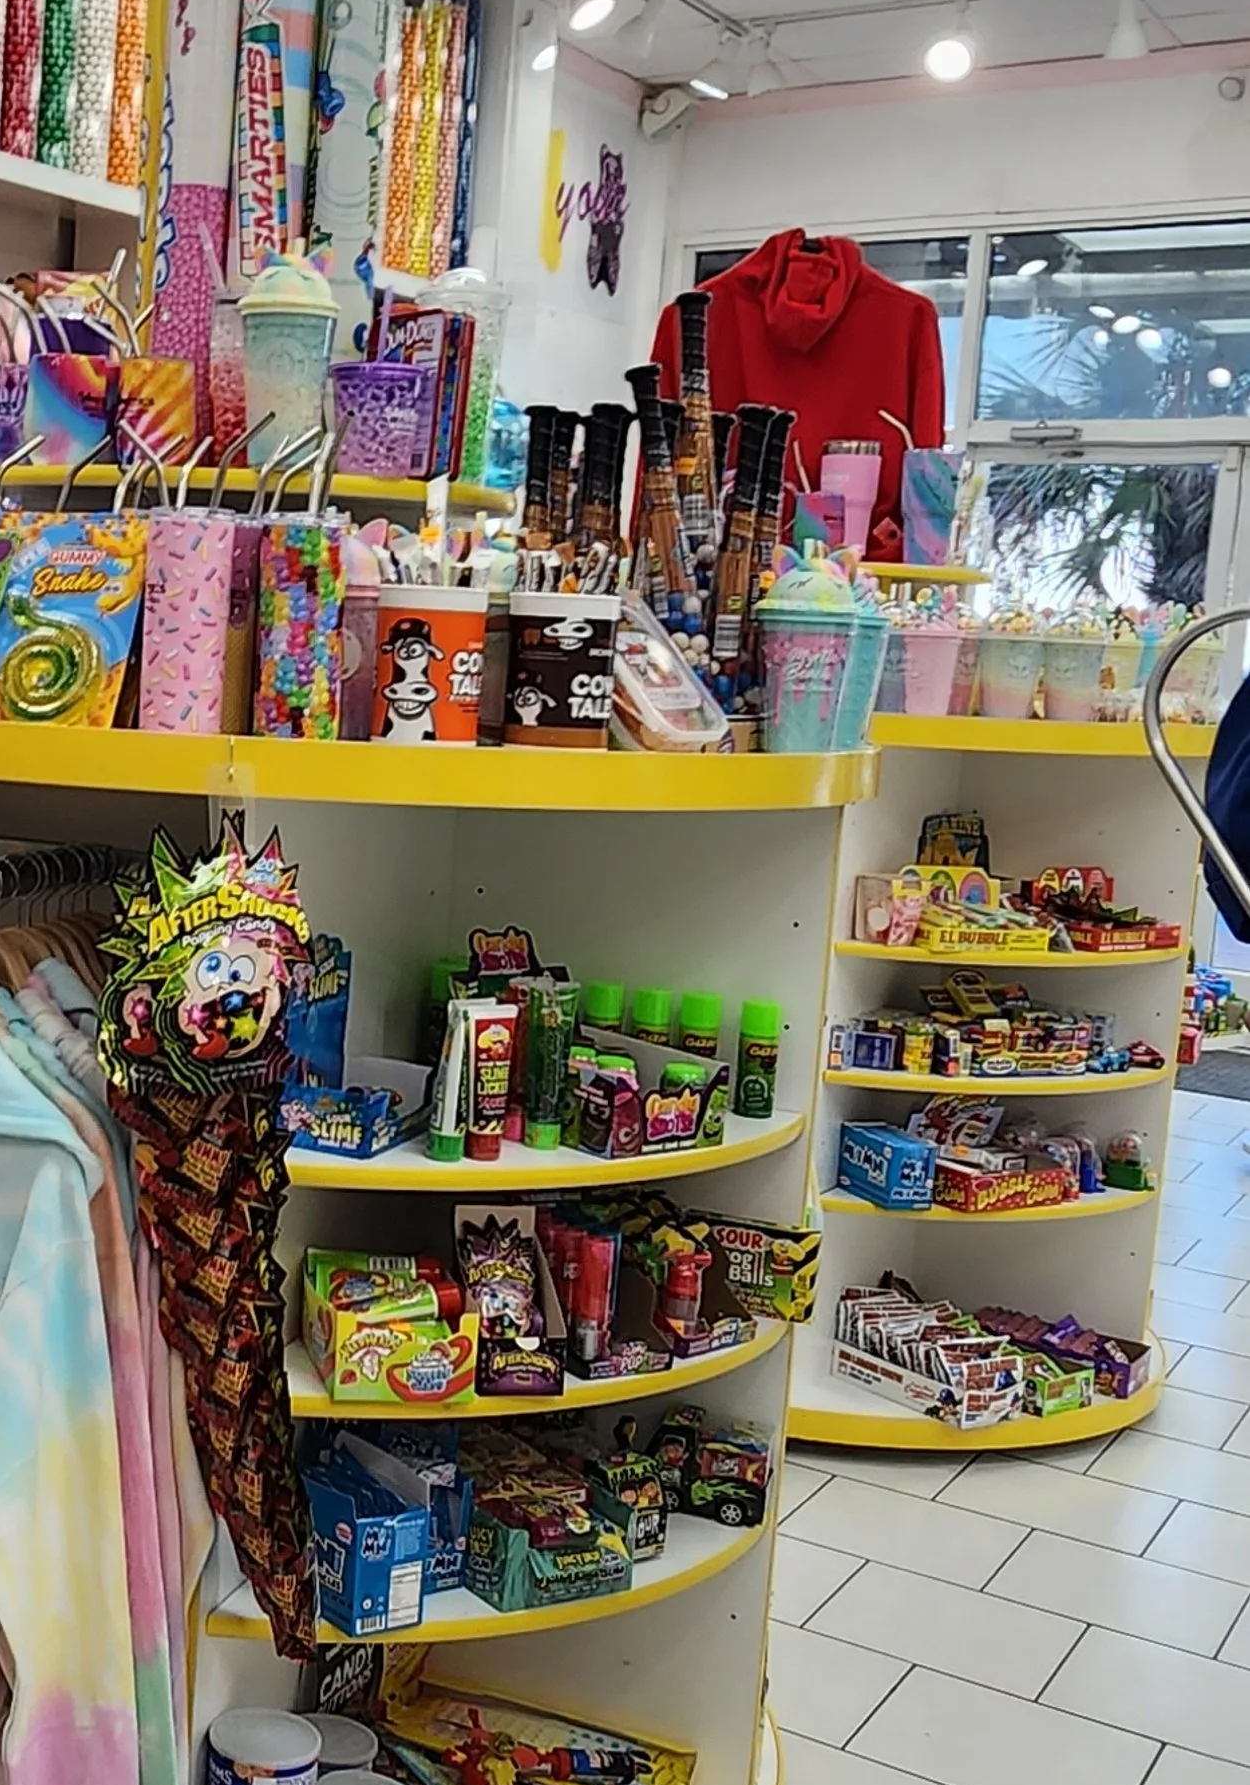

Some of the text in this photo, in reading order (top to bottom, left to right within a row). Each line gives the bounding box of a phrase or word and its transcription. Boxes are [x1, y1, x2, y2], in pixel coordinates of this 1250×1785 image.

[246, 46, 277, 255] SMARTIES
[49, 550, 107, 565] GUMMY
[32, 566, 107, 597] Snake
[182, 917, 277, 948] Popping Candy
[958, 930, 1010, 946] BUBBLE
[645, 1089, 700, 1118] Candy
[310, 1120, 364, 1146] SLIME
[977, 1174, 1061, 1211] BUBBLE GUM
[715, 1227, 764, 1250] SOUR
[728, 1252, 774, 1287] Balls
[319, 1643, 376, 1700] CANDY
